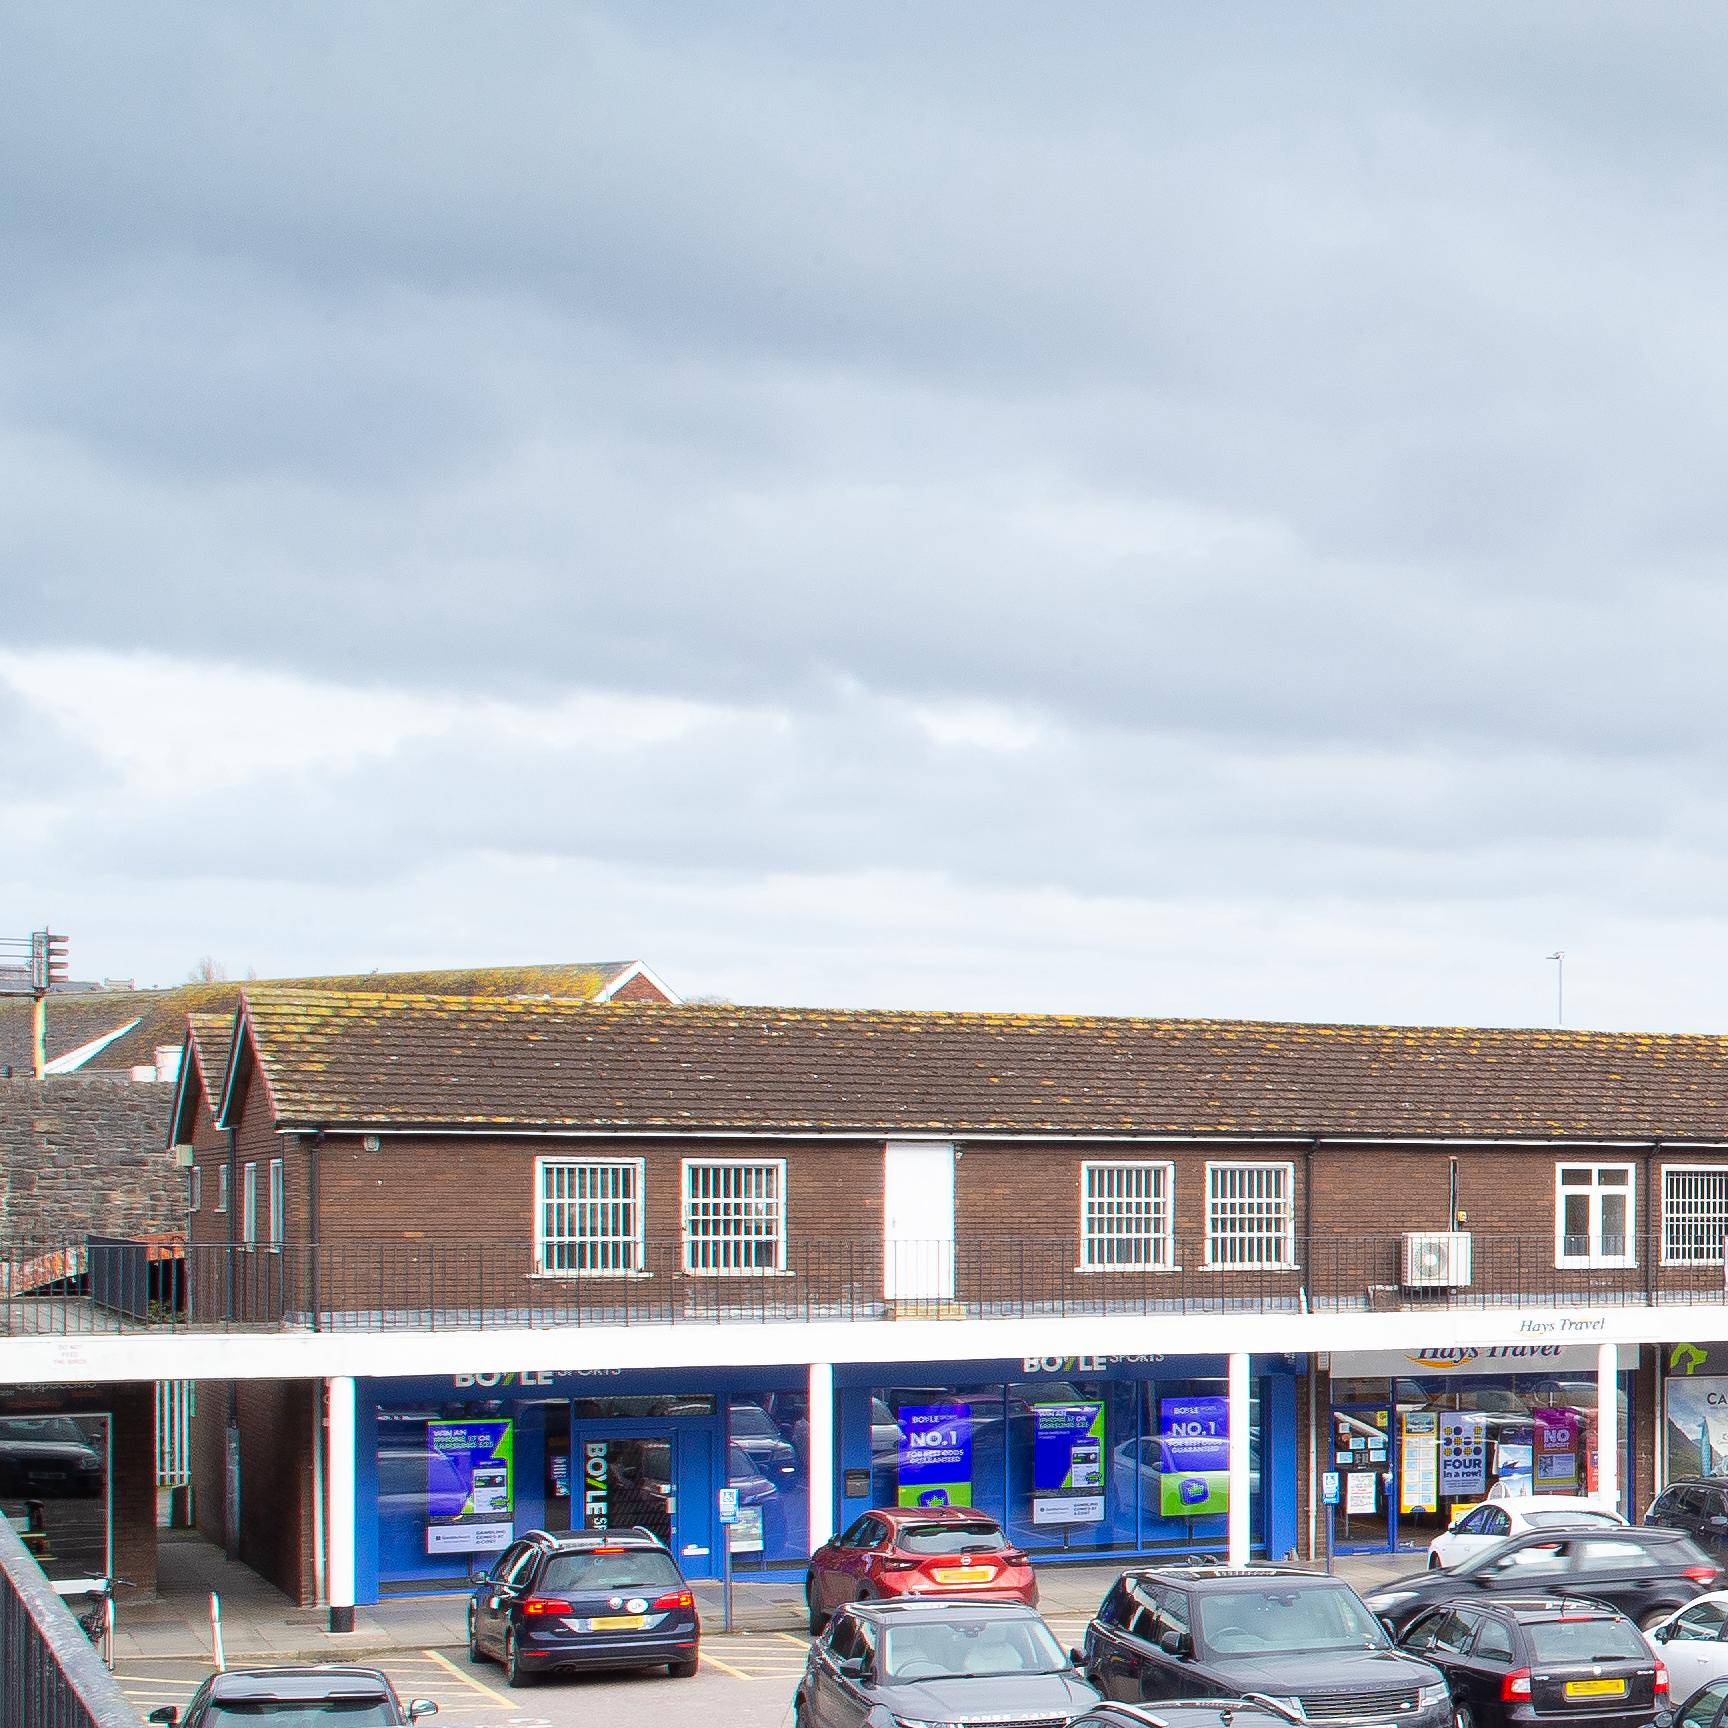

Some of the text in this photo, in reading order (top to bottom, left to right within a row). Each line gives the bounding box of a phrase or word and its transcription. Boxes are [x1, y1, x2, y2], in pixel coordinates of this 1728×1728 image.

[1519, 1318, 1606, 1335] Hays Travel
[910, 1431, 957, 1447] NO.1
[1543, 1429, 1571, 1443] NO
[1443, 1458, 1482, 1469] FOUR
[1443, 1469, 1452, 1478] in
[1454, 1470, 1461, 1478] a
